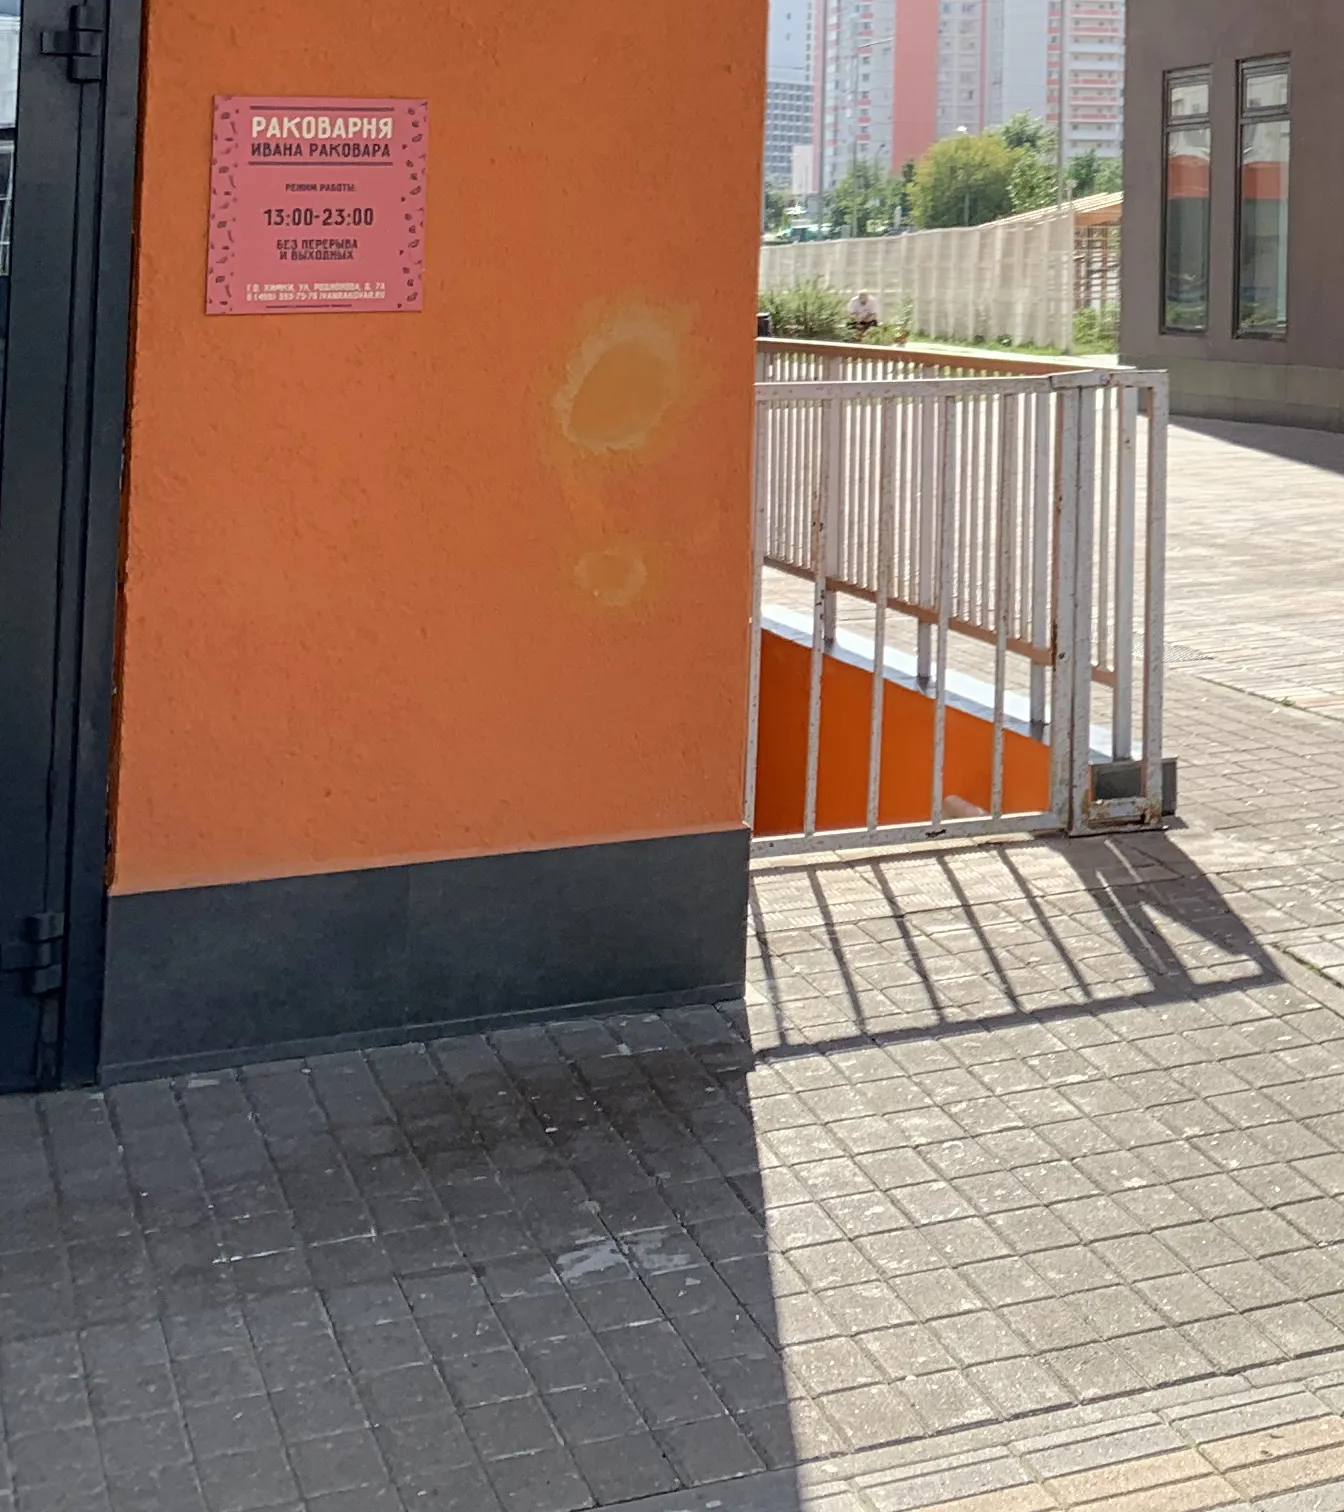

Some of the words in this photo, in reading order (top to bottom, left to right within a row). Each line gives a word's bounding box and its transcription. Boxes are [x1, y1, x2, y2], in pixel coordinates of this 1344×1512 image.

[251, 116, 393, 139] РАКОВАРНЯ
[251, 143, 303, 158] ИВАНА
[309, 143, 391, 158] РАКОВАРА
[285, 183, 317, 192] РЕЖИМ
[263, 207, 374, 226] 13:00-23:00
[276, 239, 298, 250] БЕЗ
[301, 238, 358, 249] ПЕРЕРЫВА
[279, 251, 287, 260] И
[291, 250, 354, 260] ВЫХОДНЫХ
